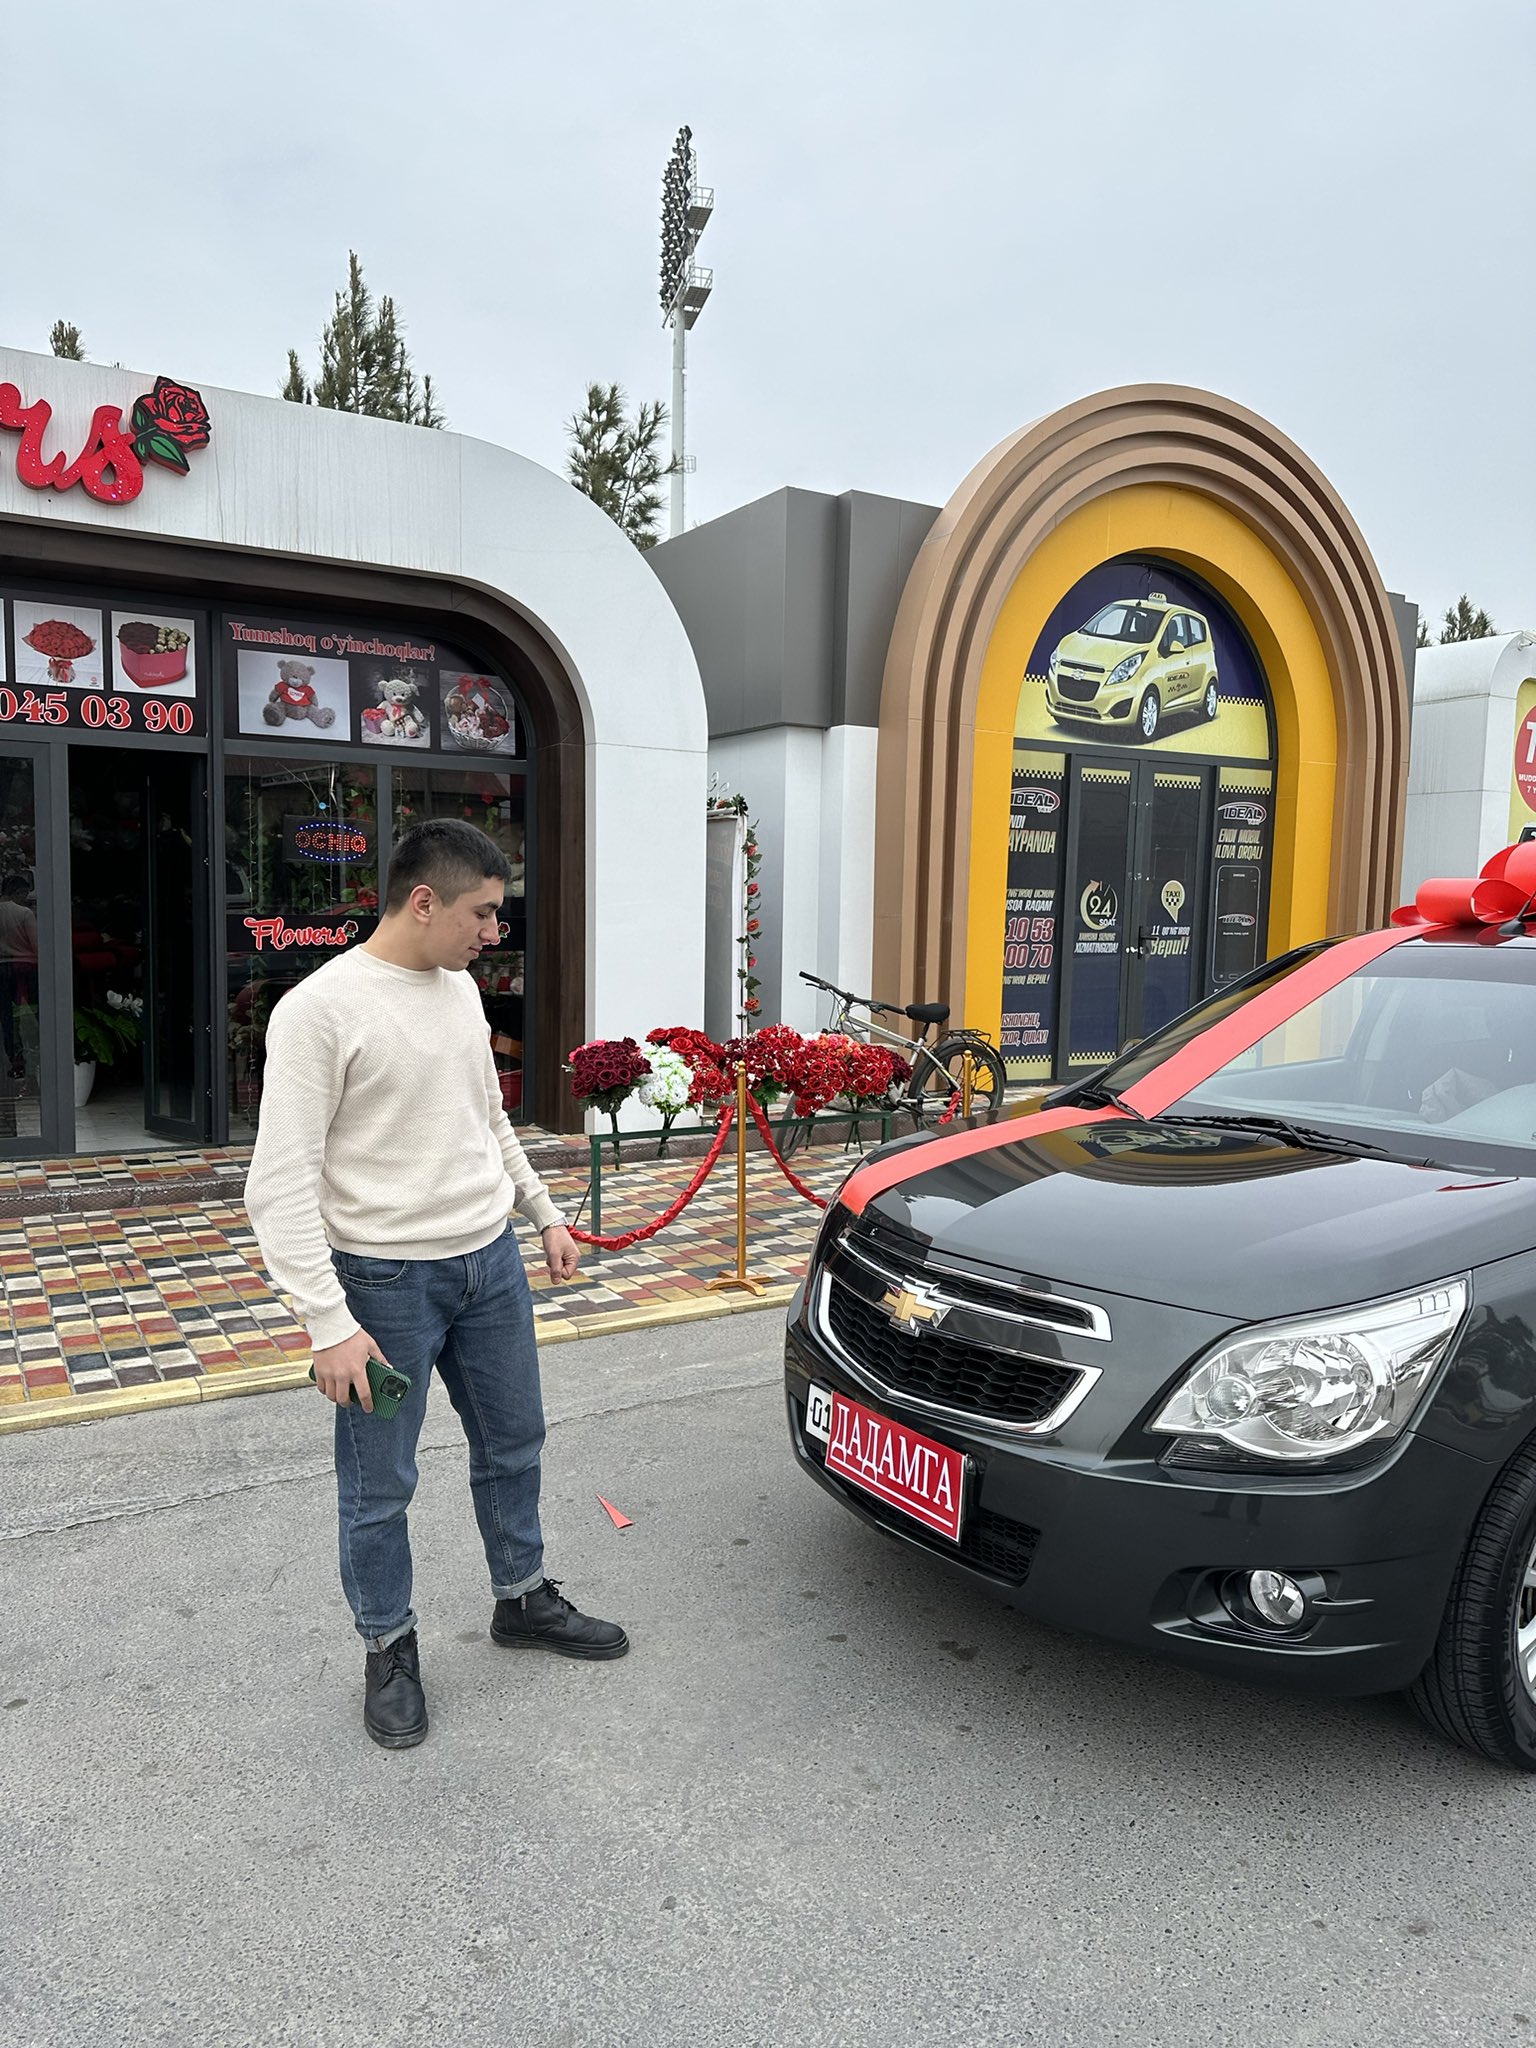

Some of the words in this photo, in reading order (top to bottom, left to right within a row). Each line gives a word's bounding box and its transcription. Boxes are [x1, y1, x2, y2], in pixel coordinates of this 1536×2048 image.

[228, 621, 317, 653] Yumshoq
[320, 633, 436, 663] o'yinchoqlar!
[80, 694, 132, 729] 03
[142, 700, 194, 733] 90
[1223, 806, 1263, 820] IDEAL
[295, 831, 367, 854] OCHIQ
[1218, 828, 1238, 843] ENDI
[1214, 844, 1236, 859] ILOVA
[1237, 845, 1263, 861] ORQALI
[1024, 899, 1053, 912] RAQAM
[1090, 895, 1112, 917] 24
[244, 916, 348, 951] Flowers
[1005, 917, 1029, 942] 10
[1030, 917, 1055, 942] 53
[1099, 919, 1116, 927] SOAT
[1151, 925, 1160, 936] 11
[1004, 943, 1029, 969] 00
[1029, 943, 1053, 969] 70
[1150, 936, 1190, 958] Bepul!
[1026, 973, 1051, 985] BEPUL!
[1022, 1029, 1049, 1046] QULAY!
[811, 1396, 831, 1434] 01
[829, 1402, 955, 1513] ДАДАМГА
